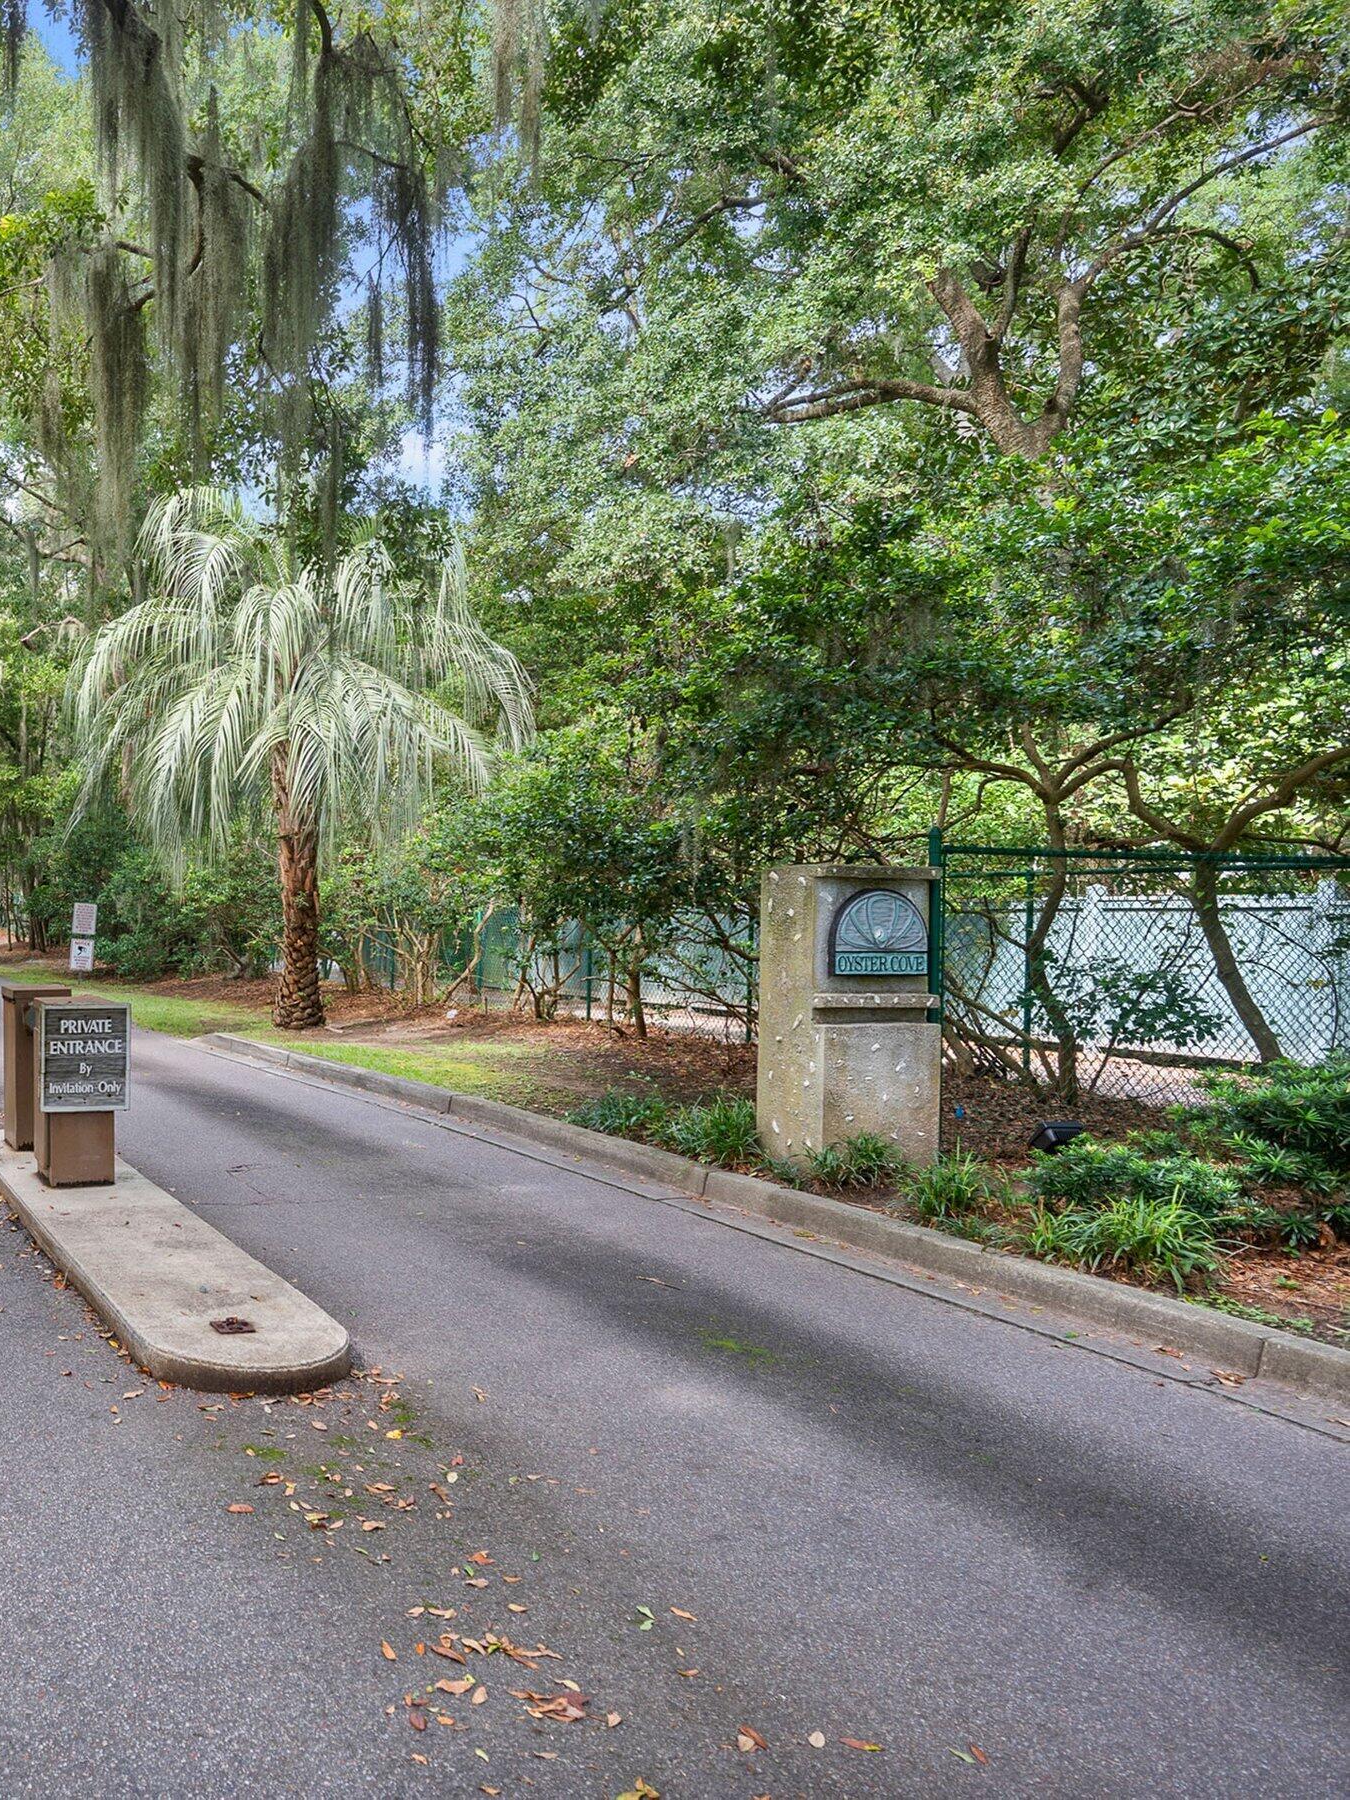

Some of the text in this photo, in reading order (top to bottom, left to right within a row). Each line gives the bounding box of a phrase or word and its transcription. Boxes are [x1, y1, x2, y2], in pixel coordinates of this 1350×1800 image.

[837, 956, 924, 972] OYSTER COVE
[60, 1019, 113, 1034] PRIVATE
[49, 1039, 123, 1055] ENTRANCE
[79, 1062, 93, 1075] By
[49, 1081, 122, 1095] Invitation Only
